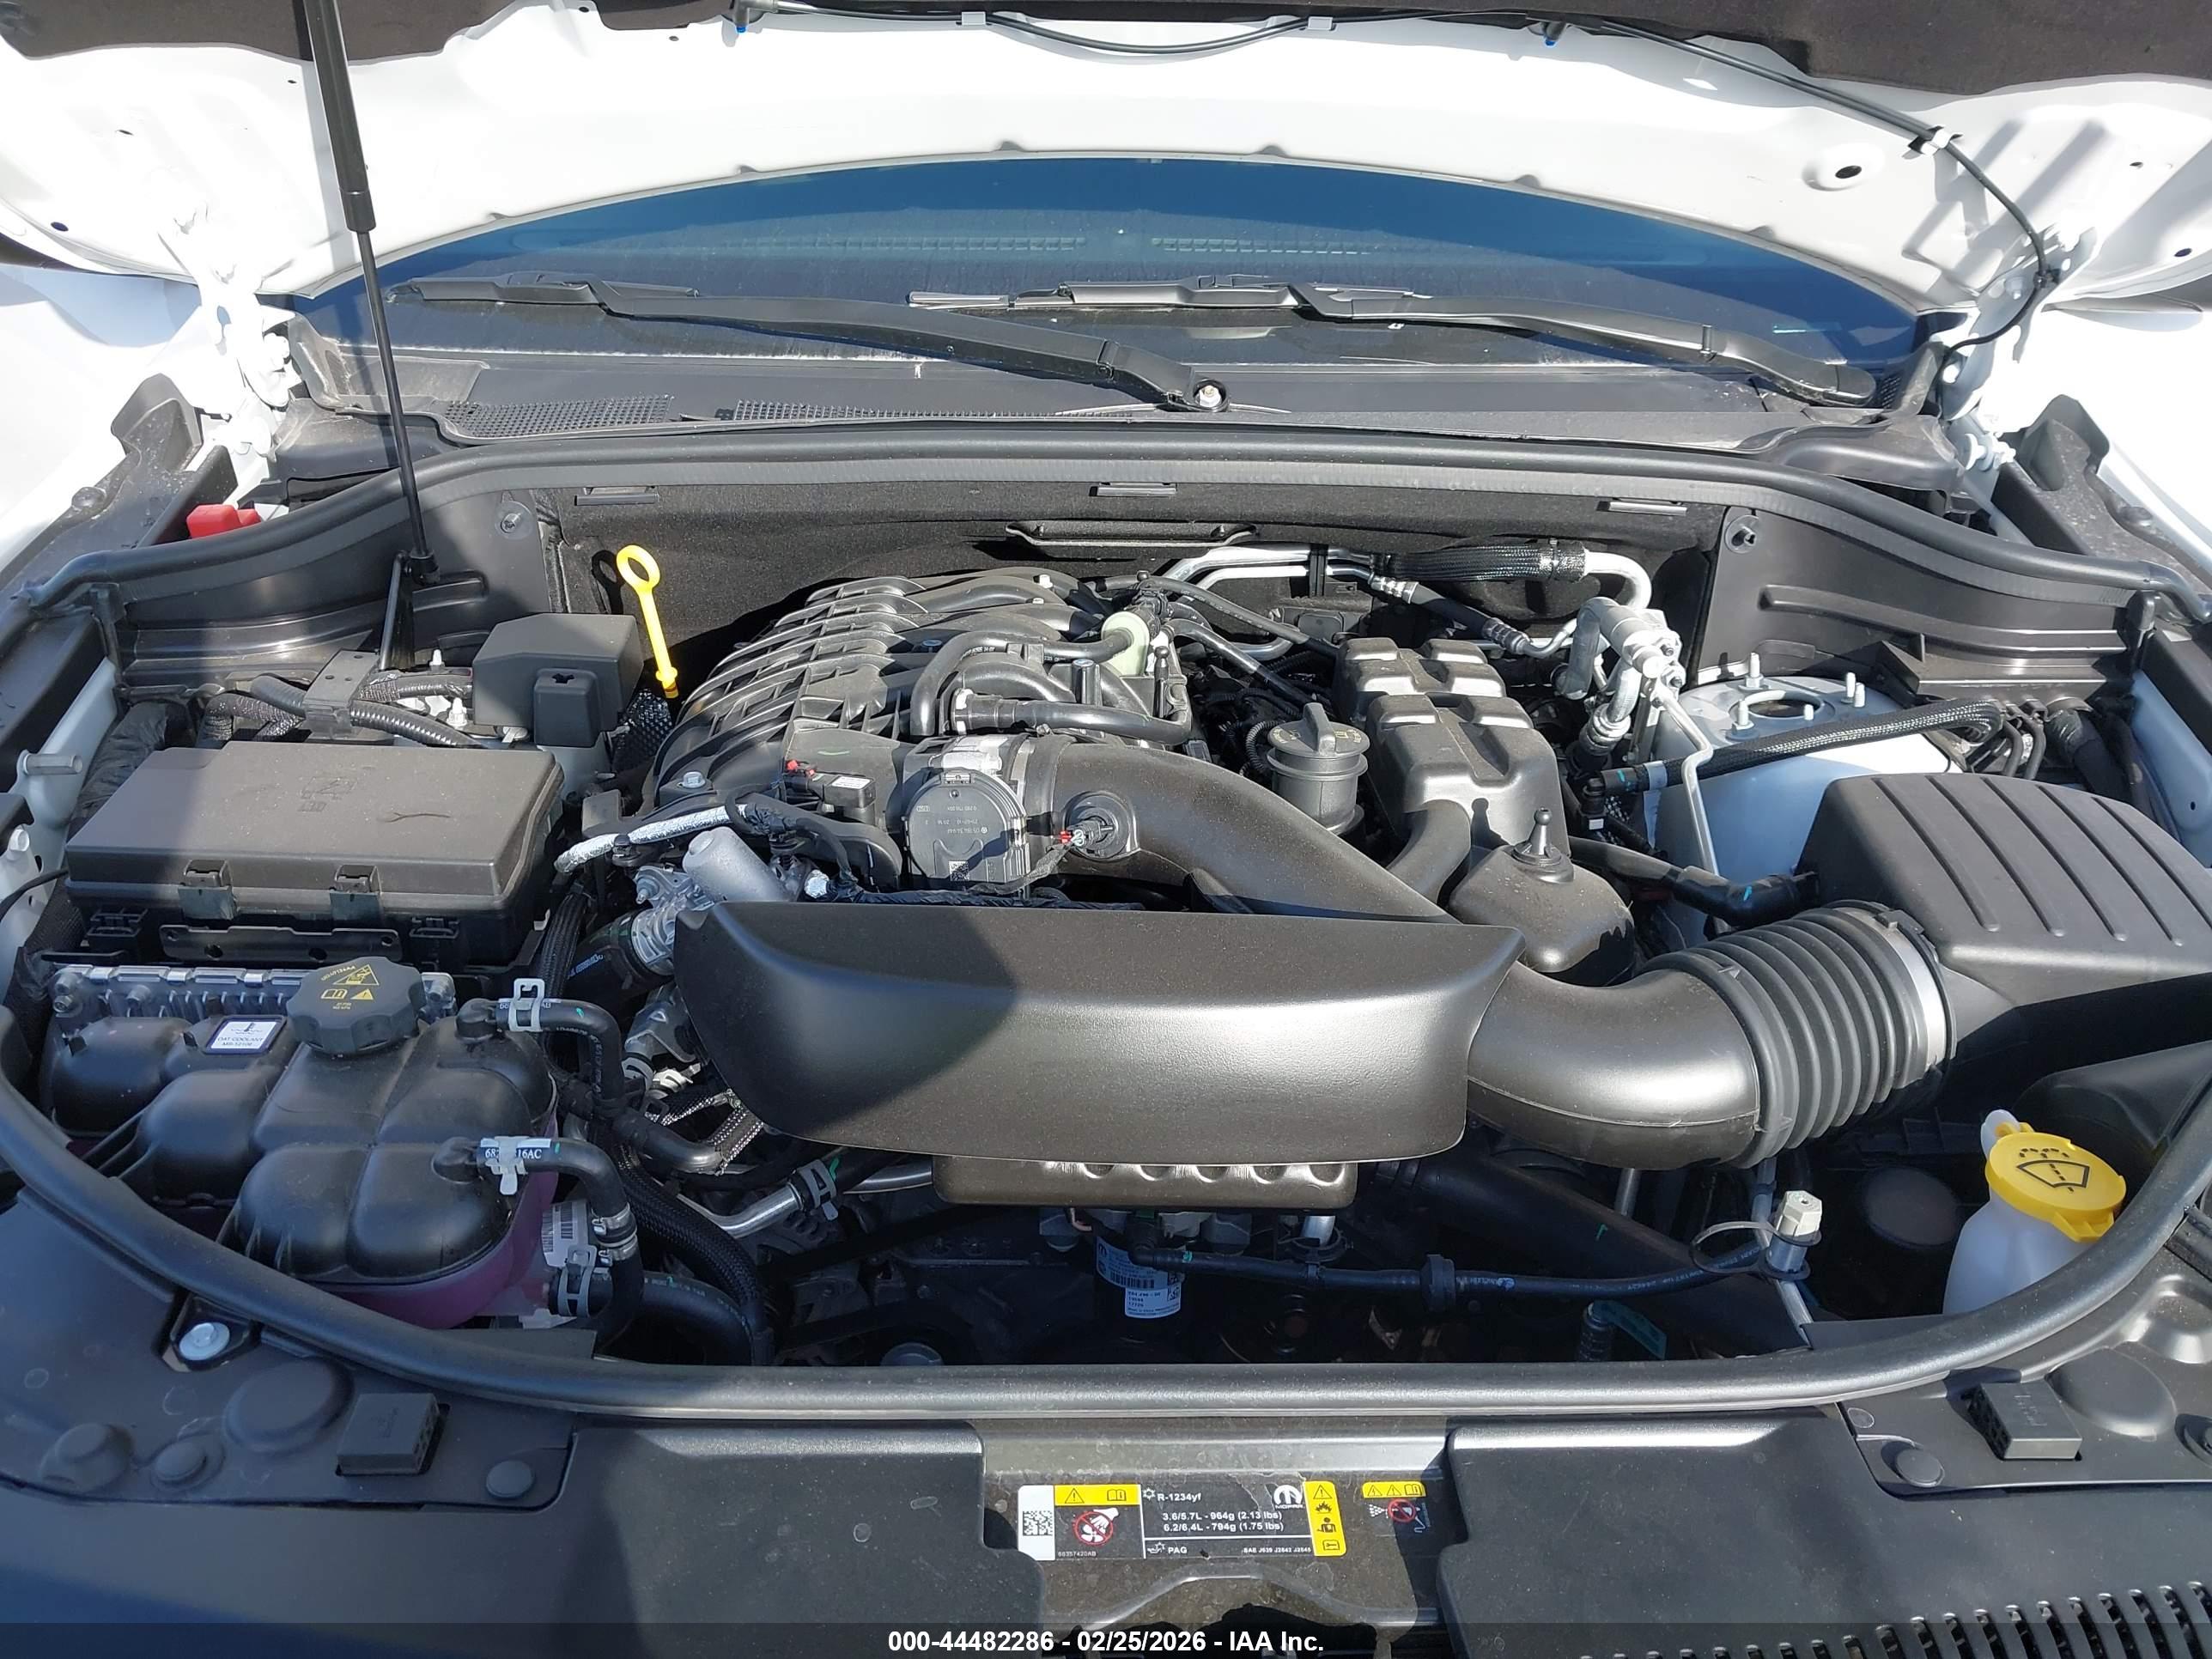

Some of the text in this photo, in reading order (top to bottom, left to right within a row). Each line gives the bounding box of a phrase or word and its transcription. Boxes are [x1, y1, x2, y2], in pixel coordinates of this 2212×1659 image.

[1157, 1492, 1202, 1503] R-1234yf
[1162, 1512, 1203, 1521] 3.6/5.7L
[1210, 1511, 1236, 1522] 964g
[1237, 1510, 1261, 1522] (2.13
[1263, 1510, 1282, 1521] lbs)
[1164, 1523, 1204, 1532] 6.2/6.4L
[1212, 1522, 1237, 1533] 794g
[1239, 1522, 1263, 1532] (1.75
[1265, 1522, 1284, 1532] lbs)
[1168, 1546, 1188, 1554] PAG
